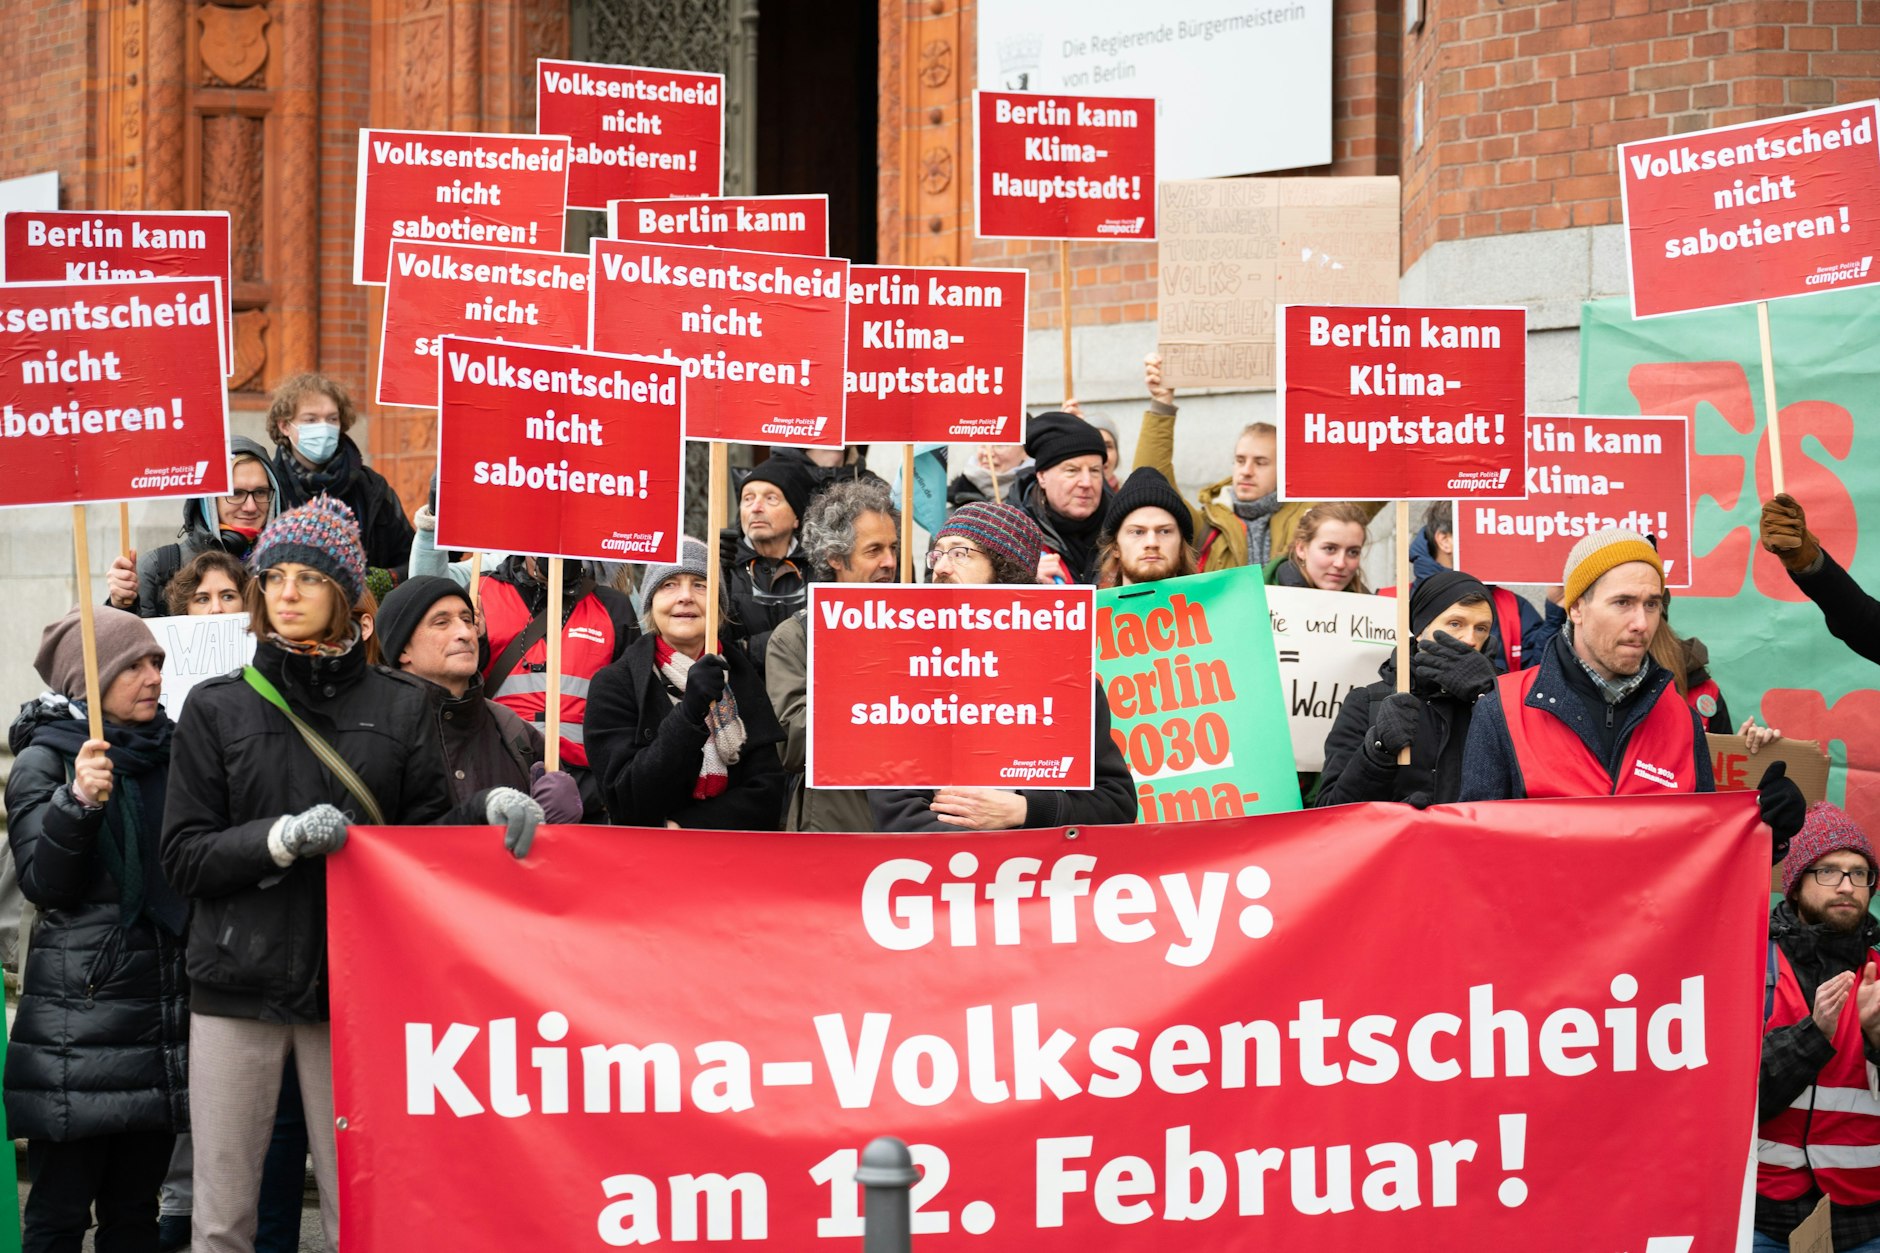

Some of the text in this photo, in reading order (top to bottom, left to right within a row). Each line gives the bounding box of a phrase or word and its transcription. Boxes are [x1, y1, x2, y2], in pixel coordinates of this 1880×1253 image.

[1062, 2, 1305, 58] Die Regierende Bürgermeisterin
[544, 71, 718, 106] Volksentscheid
[1062, 61, 1136, 88] von Berlin
[602, 109, 662, 135] nicht
[996, 99, 1071, 126] Berlin
[1077, 102, 1138, 128] kann
[373, 141, 563, 172] Volksentscheid
[569, 142, 697, 172] sabotieren!
[1025, 136, 1108, 163] Klima-
[1630, 116, 1873, 180] Volksentscheid
[436, 179, 501, 206] nicht
[992, 172, 1141, 204] Hauptstadt!
[1163, 182, 1267, 208] WAS IRIS
[1713, 175, 1797, 210] nicht
[27, 219, 206, 249] Berlin kann
[392, 215, 538, 245] sabotieren!
[639, 205, 806, 234] Berlin kann
[1665, 206, 1851, 259] sabotieren!
[397, 252, 589, 292] Volksentsche
[602, 253, 841, 298] Volksentscheid
[1805, 256, 1873, 285] campact!
[849, 274, 1002, 308] erlin kann
[465, 296, 538, 325] nicht
[681, 304, 762, 338] nicht
[863, 318, 964, 350] Klima-
[1310, 314, 1500, 349] Berlin kann
[22, 350, 121, 384] nicht
[448, 351, 676, 406] Volksentscheid
[632, 349, 811, 387] otieren!
[846, 365, 1004, 400] auptstadt!
[1350, 363, 1461, 396] Klima-
[526, 409, 603, 446] nicht
[761, 416, 827, 438] campact!
[773, 416, 815, 425] Bewegt Politik
[949, 416, 1008, 437] campact!
[1304, 412, 1505, 452] Hauptstadt!
[1527, 422, 1662, 454] lin kann
[131, 461, 209, 490] campact!
[144, 465, 195, 475] Bewegt Politik
[473, 456, 648, 499] sabotieren!
[1447, 468, 1511, 492] campact!
[1527, 465, 1624, 495] Klima-
[601, 531, 664, 554] campact!
[612, 531, 653, 540] Bewegt Politik
[820, 599, 1086, 631] Volksentscheid
[1306, 613, 1338, 633] und
[1351, 614, 1397, 641] Klima
[909, 646, 999, 678] nicht
[1097, 653, 1236, 719] erlin
[1292, 679, 1354, 719] Wah
[851, 694, 1054, 726] sabotieren!
[1000, 756, 1074, 780] campact!
[1013, 759, 1060, 768] Bewegt Politik
[1136, 782, 1259, 824] ima-
[861, 851, 1274, 968] Giffey:
[404, 973, 1708, 1118] Klima-Volksentscheid
[597, 1169, 768, 1246] am
[1035, 1113, 1527, 1228] Februar!
